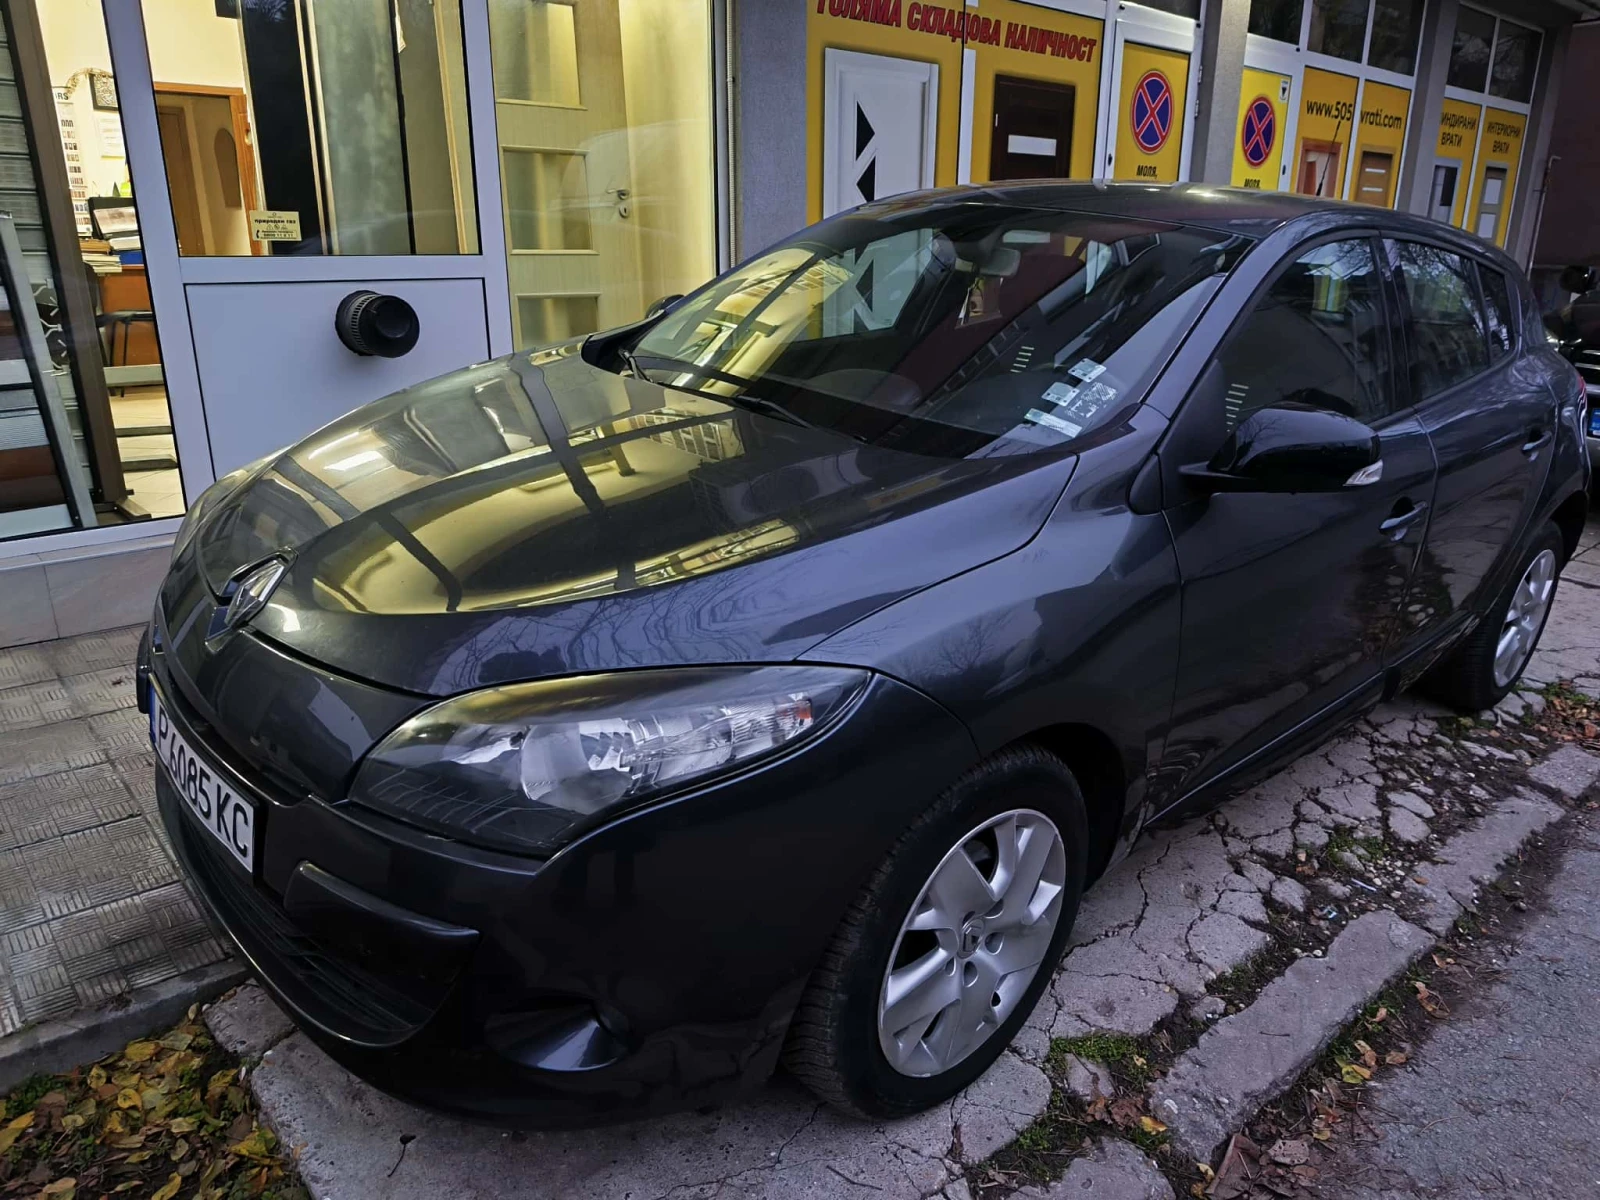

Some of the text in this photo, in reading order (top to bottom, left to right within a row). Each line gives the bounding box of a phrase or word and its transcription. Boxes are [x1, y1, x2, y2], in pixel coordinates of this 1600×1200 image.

[906, 2, 1001, 46] СКЛАДОВА
[1004, 22, 1097, 63] НАЛИЧНОСТ
[1441, 132, 1463, 148] ВРАТИ
[1492, 140, 1510, 154] ВРАТИ
